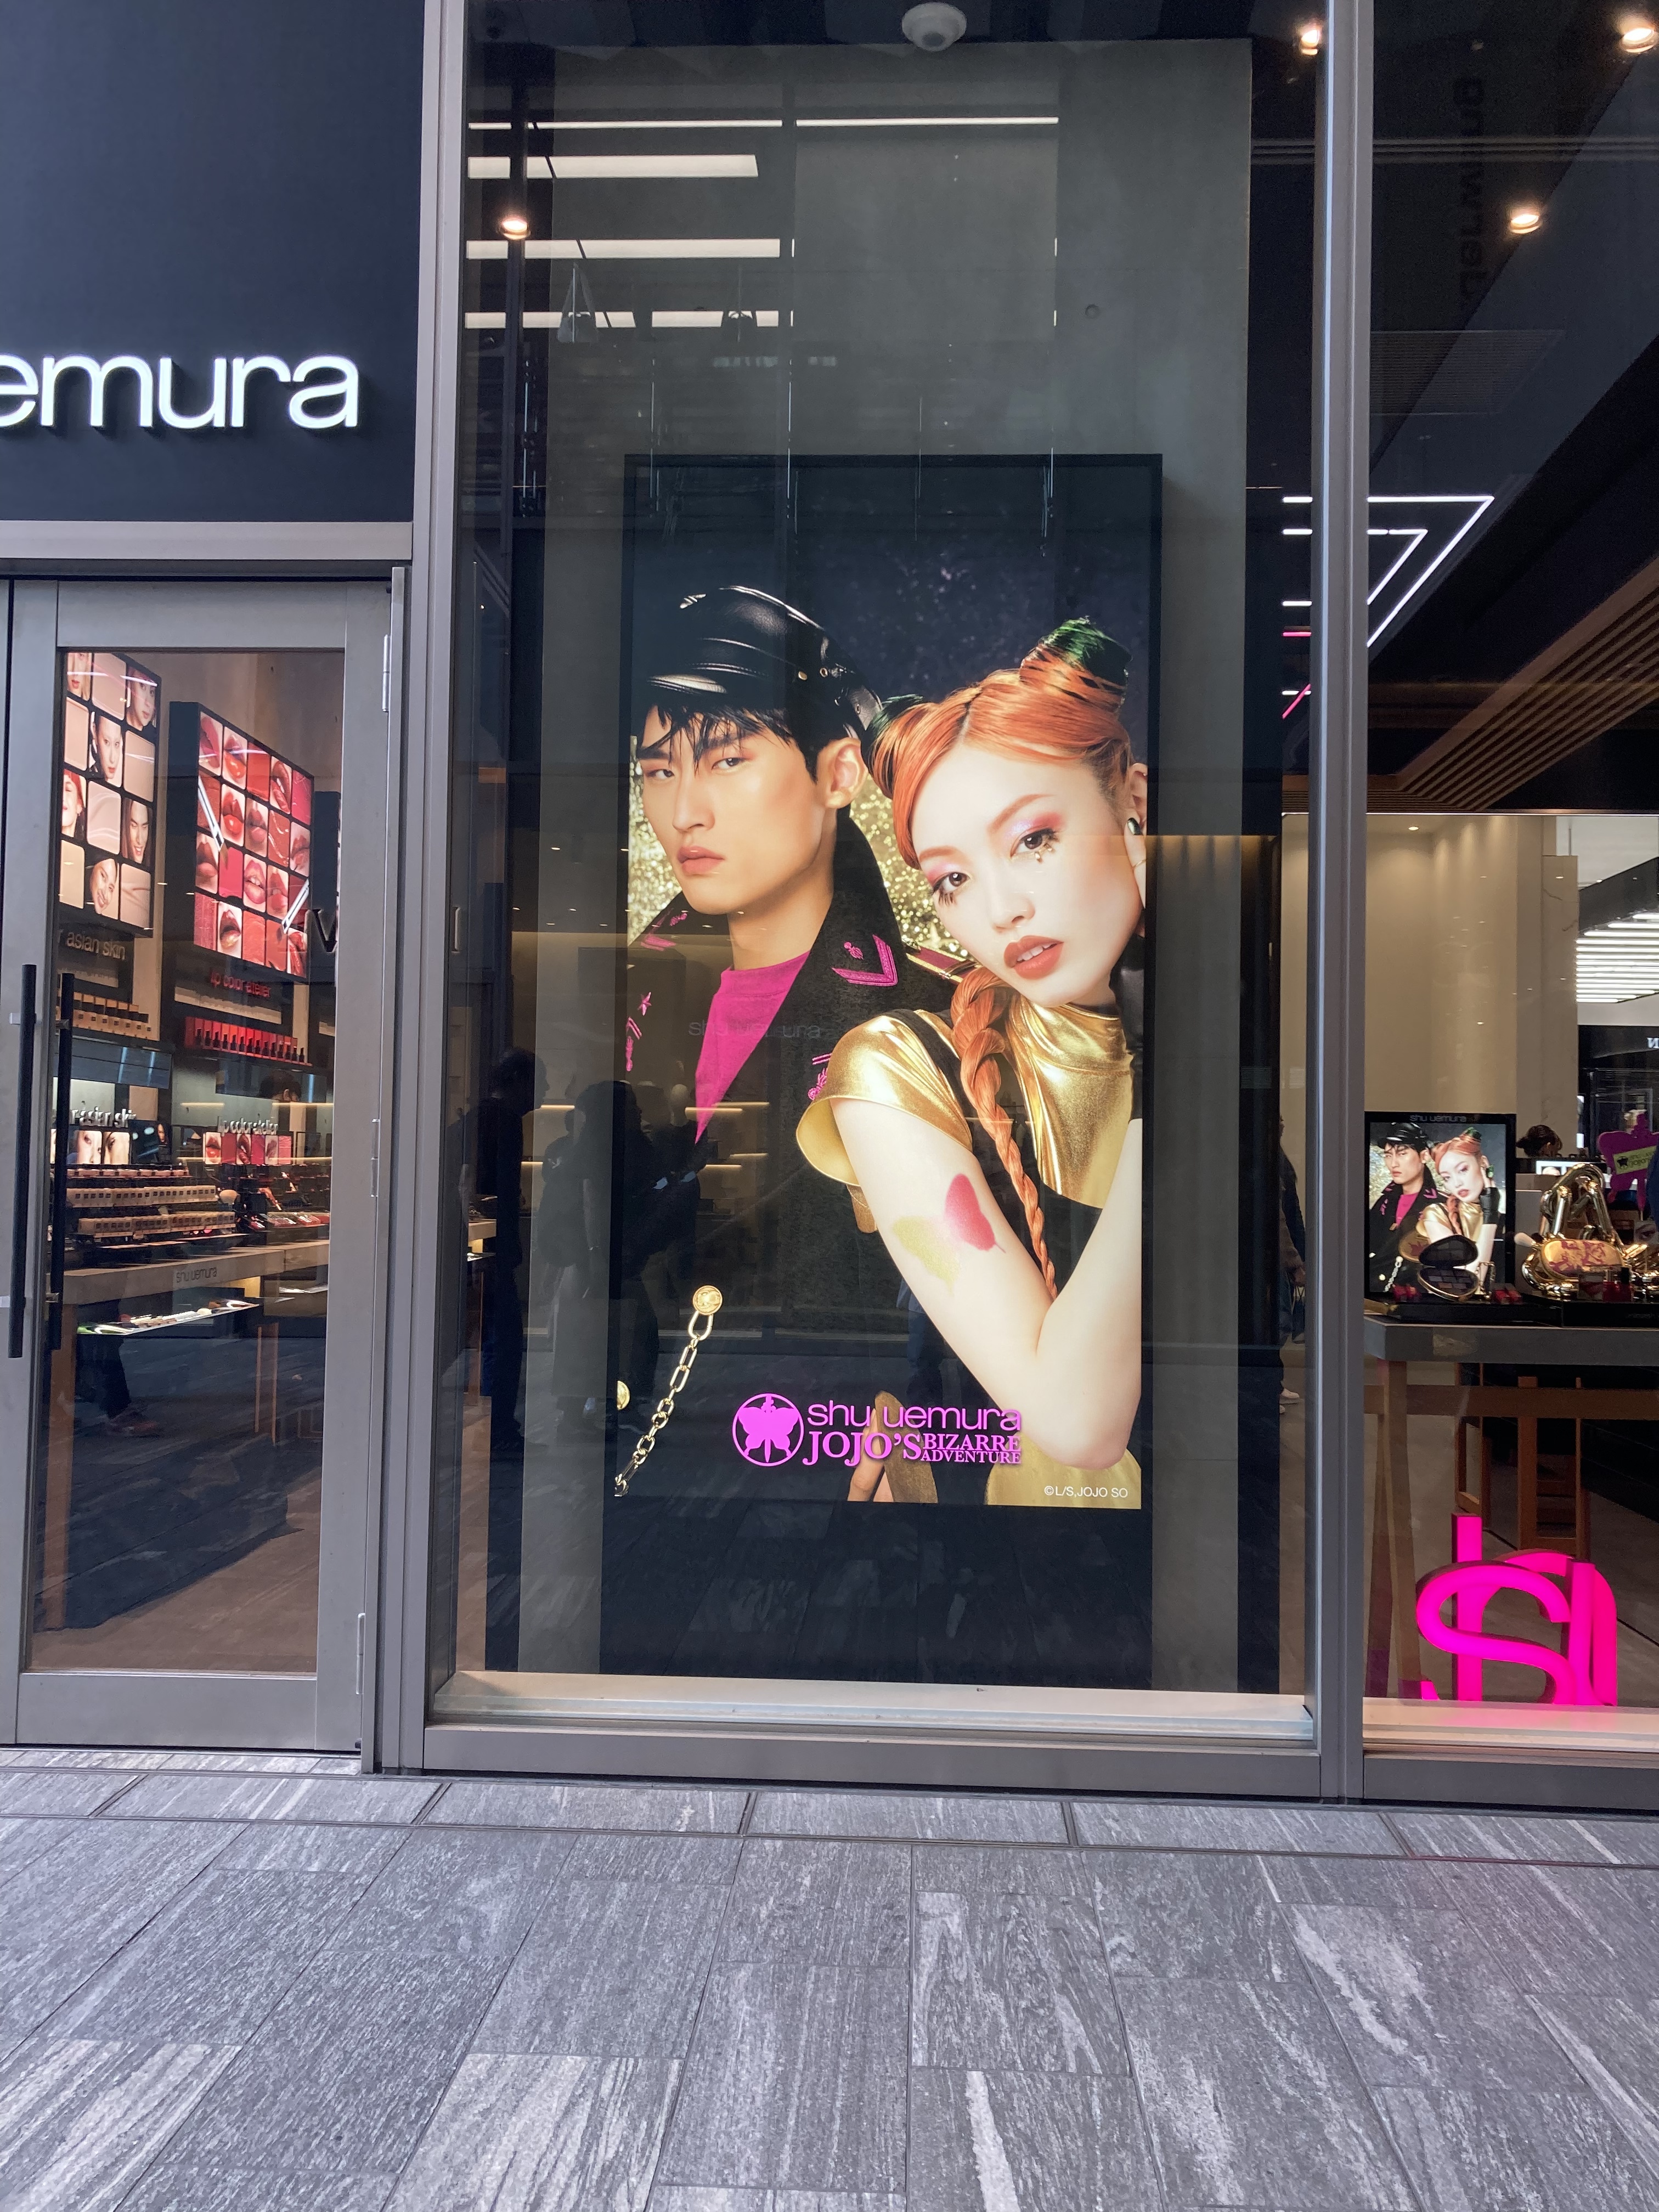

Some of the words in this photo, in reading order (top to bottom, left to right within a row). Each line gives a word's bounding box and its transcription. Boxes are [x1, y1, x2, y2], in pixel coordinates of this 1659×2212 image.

[66, 932, 99, 953] asian
[103, 941, 125, 960] skin
[223, 975, 245, 991] color
[245, 981, 271, 997] atelier
[807, 1400, 871, 1426] shu
[883, 1406, 1021, 1431] uemura
[803, 1430, 922, 1467] JOJO'S
[923, 1433, 1022, 1453] BIZARRE
[921, 1449, 1022, 1464] ADVENTURE
[1111, 1487, 1128, 1498] SO
